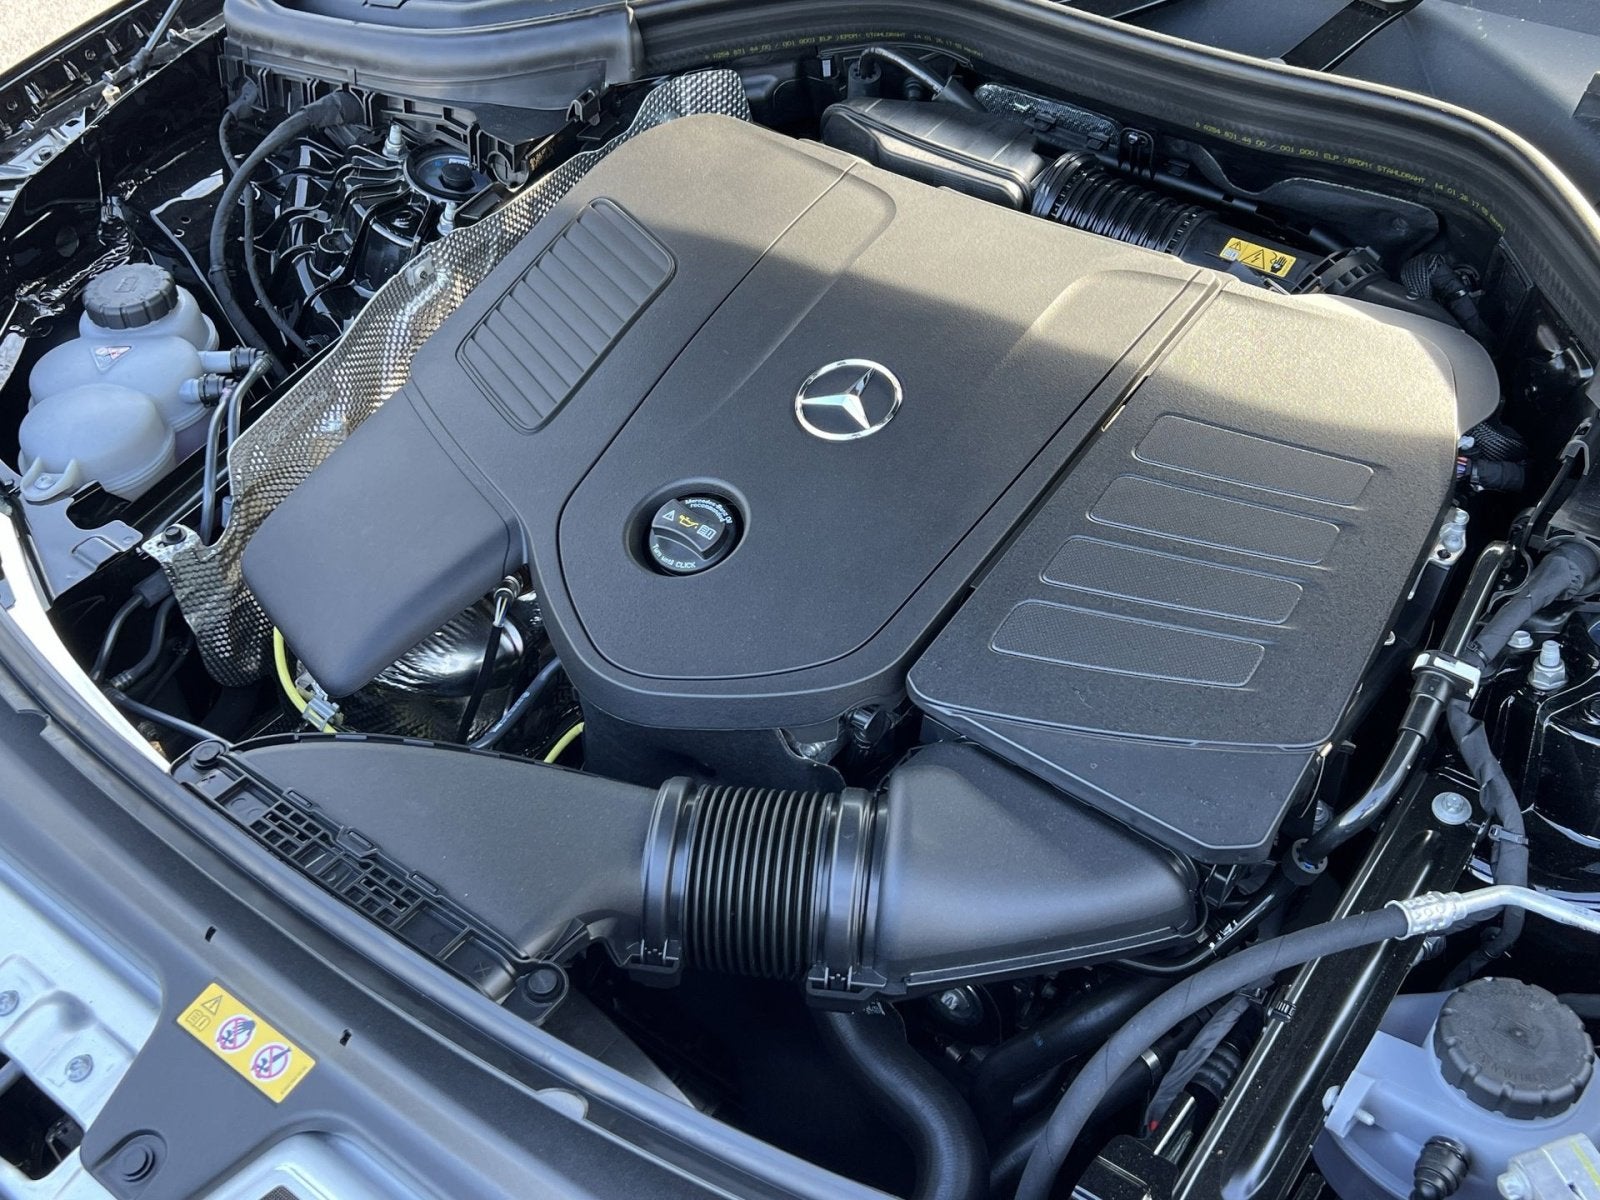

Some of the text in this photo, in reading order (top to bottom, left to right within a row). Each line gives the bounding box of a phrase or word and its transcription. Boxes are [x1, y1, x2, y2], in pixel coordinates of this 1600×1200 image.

[685, 499, 728, 517] Mercedes-Benz
[652, 543, 697, 569] Turn until CLICK
